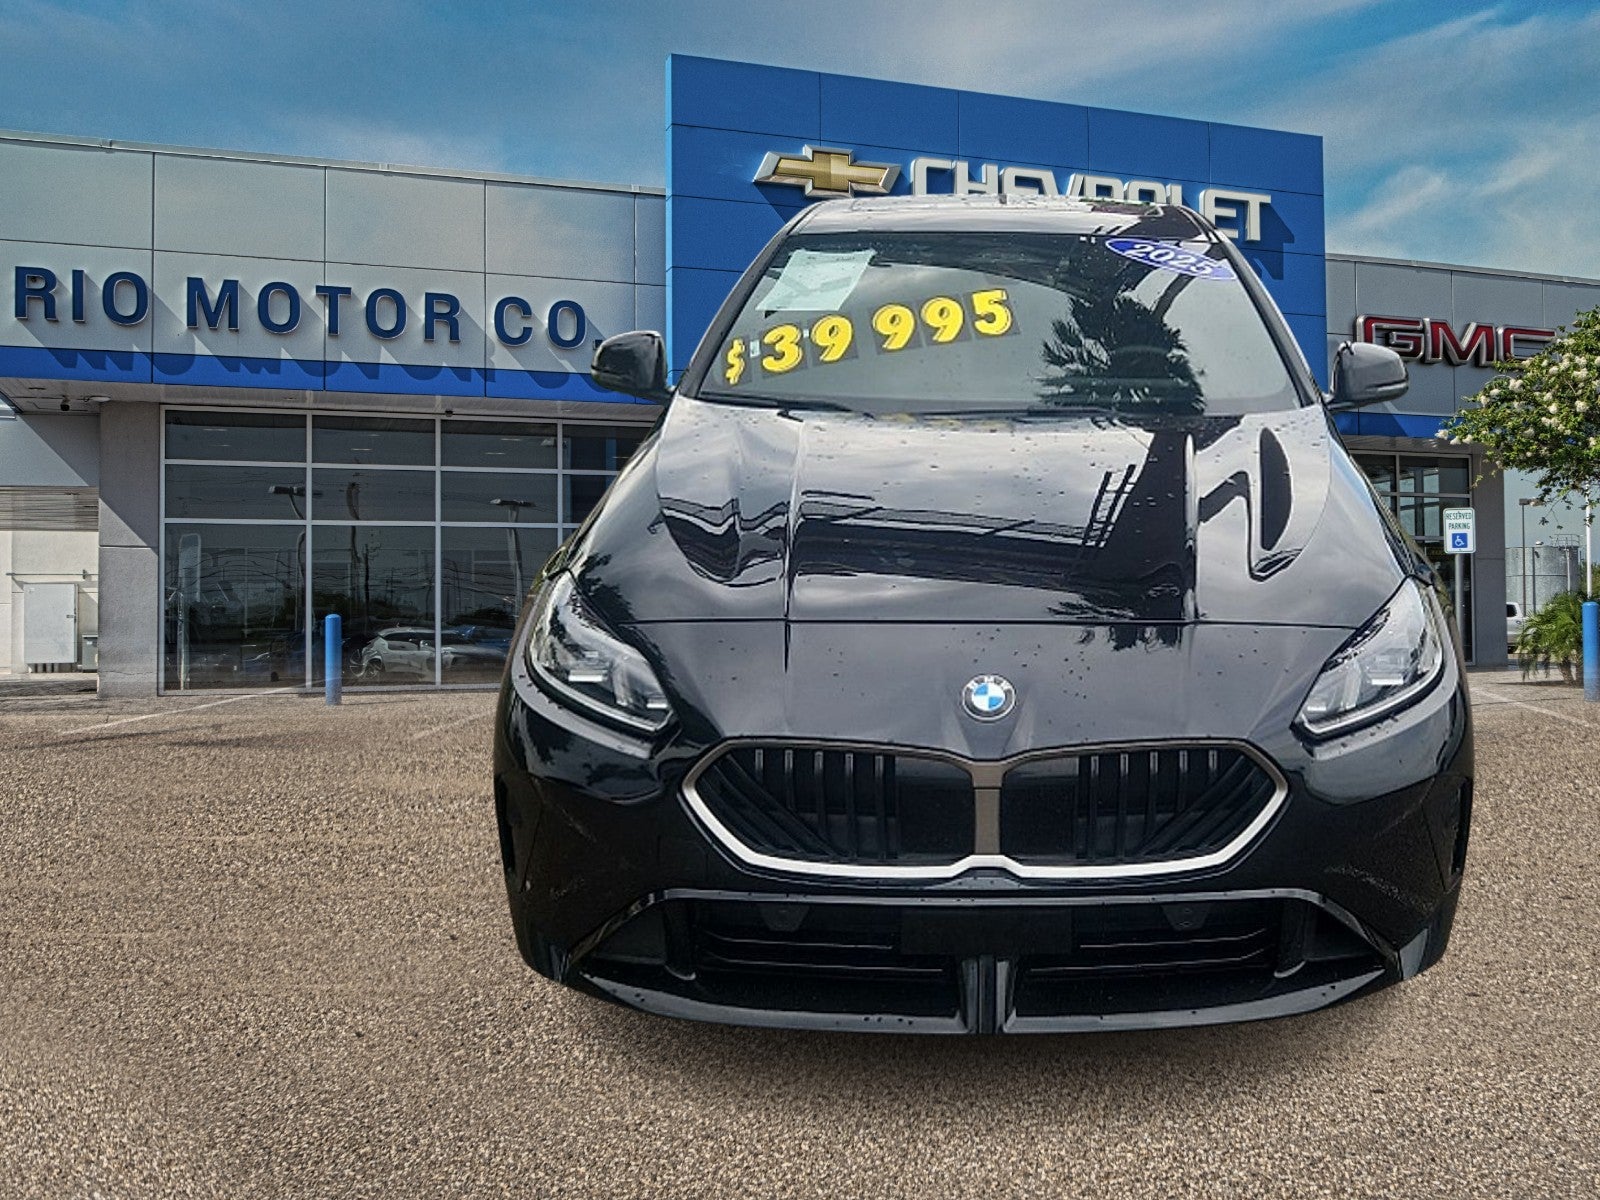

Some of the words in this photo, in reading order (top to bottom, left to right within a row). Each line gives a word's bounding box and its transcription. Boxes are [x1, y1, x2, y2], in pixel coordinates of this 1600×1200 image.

[1124, 243, 1214, 275] 2025
[15, 266, 148, 326] RIO
[187, 276, 461, 344] MOTOR
[1356, 314, 1556, 367] GMC
[1446, 512, 1472, 520] RESERVED
[1448, 522, 1471, 530] PARKING
